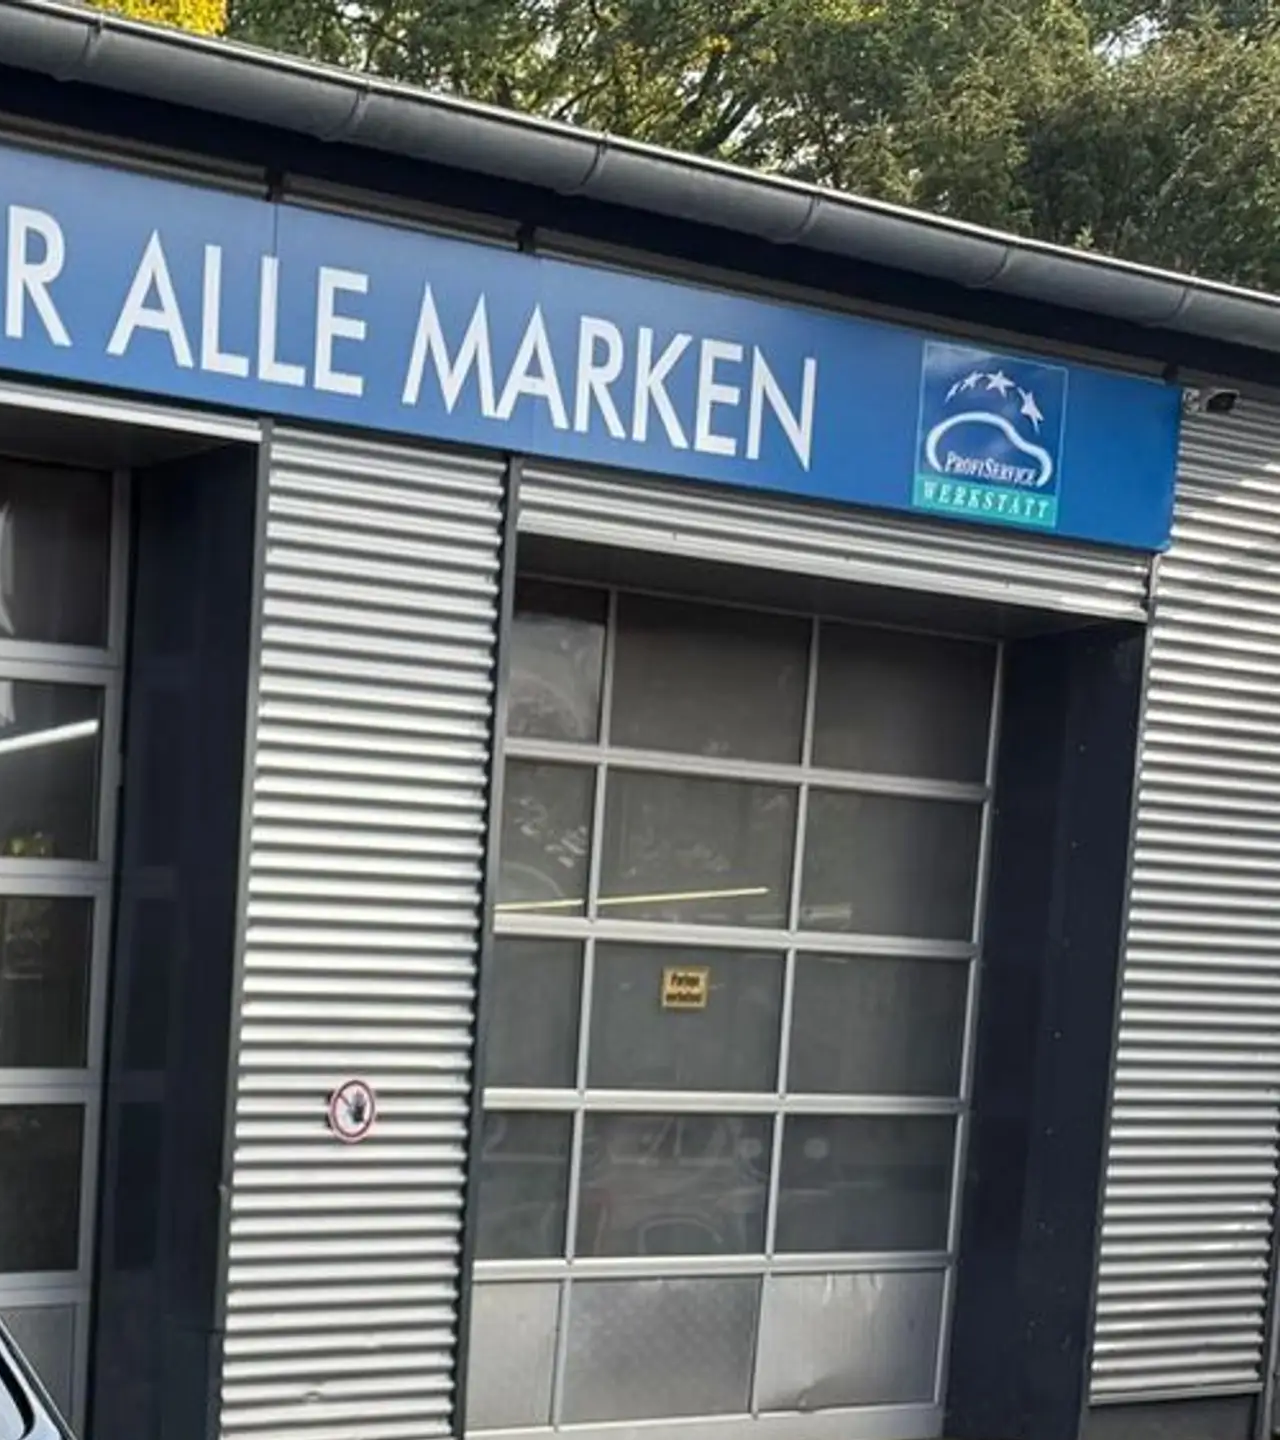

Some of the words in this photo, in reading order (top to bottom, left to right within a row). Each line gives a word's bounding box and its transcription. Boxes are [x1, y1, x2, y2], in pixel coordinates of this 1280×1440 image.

[106, 230, 369, 397] ALLE
[402, 283, 817, 471] MARKEN
[923, 480, 1050, 518] WERKSTATT
